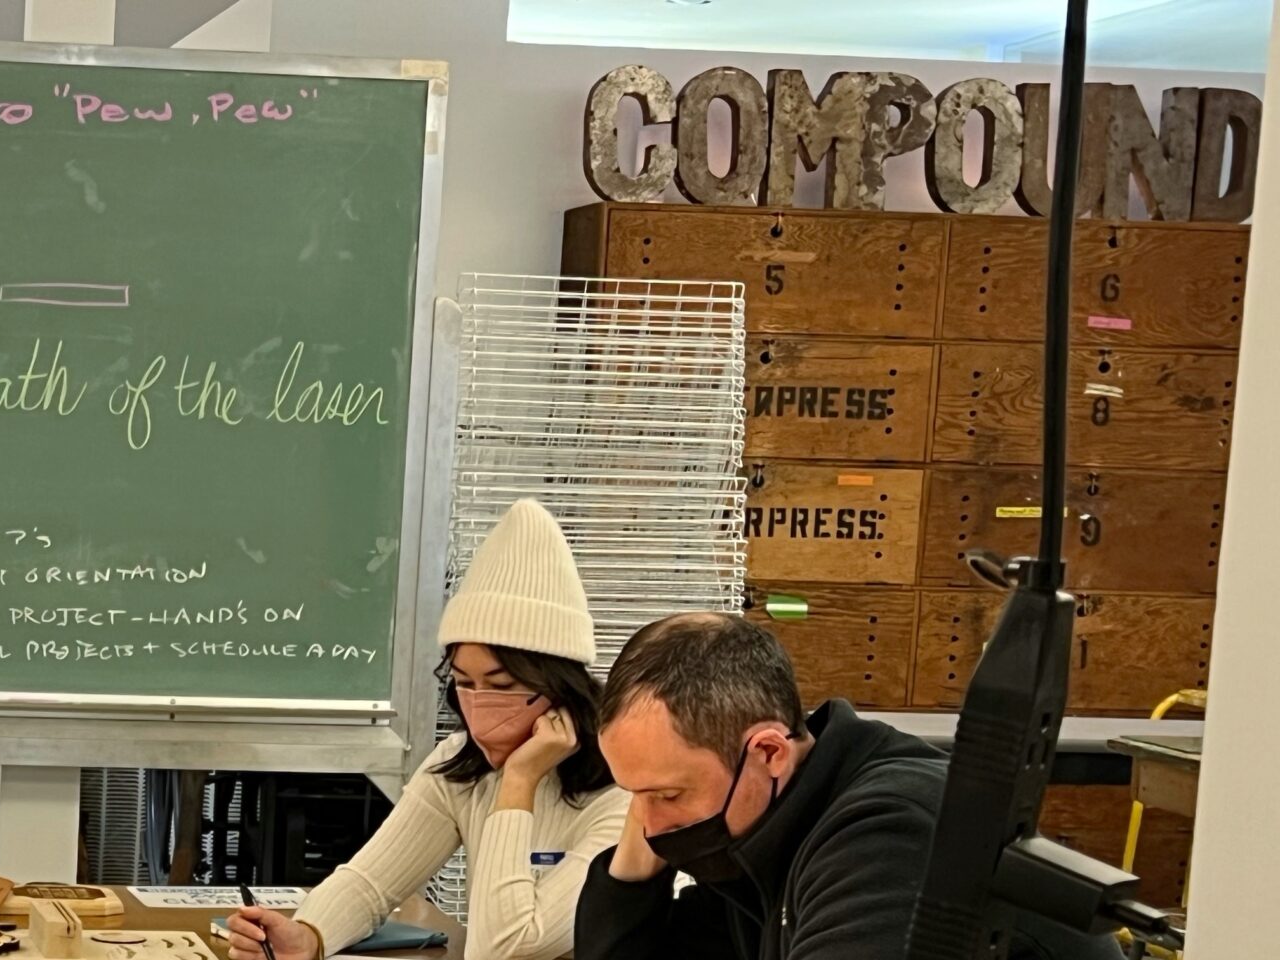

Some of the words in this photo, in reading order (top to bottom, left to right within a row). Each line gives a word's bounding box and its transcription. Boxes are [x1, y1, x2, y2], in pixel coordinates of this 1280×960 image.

[583, 63, 1264, 223] COMPOUND
[764, 264, 785, 296] 5
[1099, 273, 1121, 302] 6
[107, 354, 167, 450] of
[175, 354, 244, 425] the
[266, 340, 390, 426] laser
[1090, 396, 1111, 428] 8
[1079, 515, 1102, 547] 9
[24, 560, 207, 585] ORIENTATION
[263, 602, 305, 622] ON
[26, 639, 134, 661] PROJECTS
[169, 640, 298, 658] SCHEDULE
